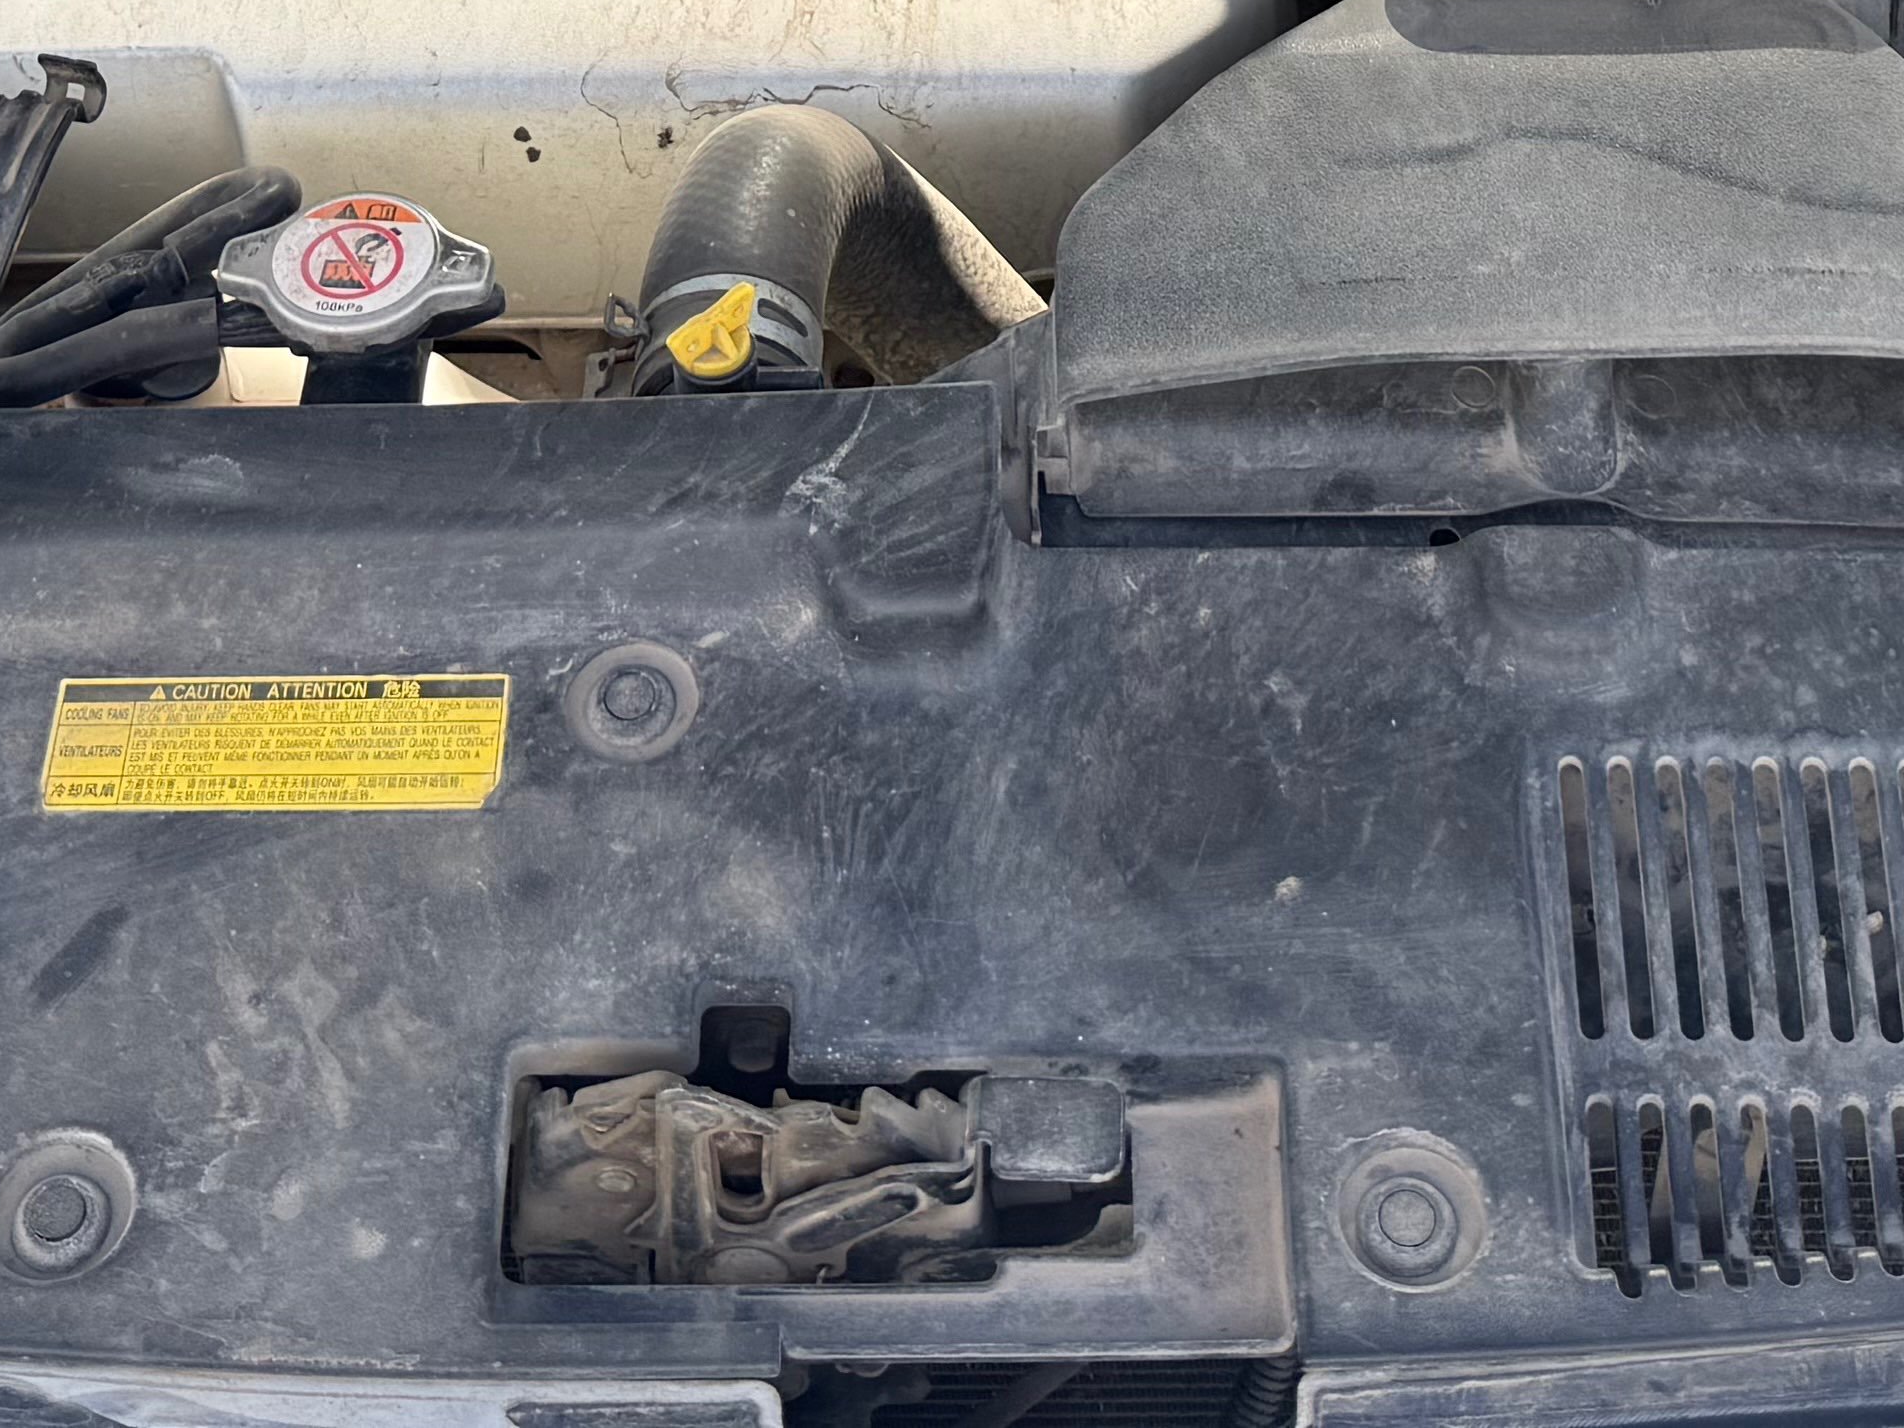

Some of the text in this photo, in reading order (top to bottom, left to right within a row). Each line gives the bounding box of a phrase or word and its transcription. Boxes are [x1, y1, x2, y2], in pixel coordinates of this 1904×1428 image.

[172, 682, 368, 700] CAUTION ATTENTION
[65, 707, 130, 721] COOLING FANS
[58, 744, 124, 758] VENTILATEURS
[50, 782, 116, 798] 冷却风扇
